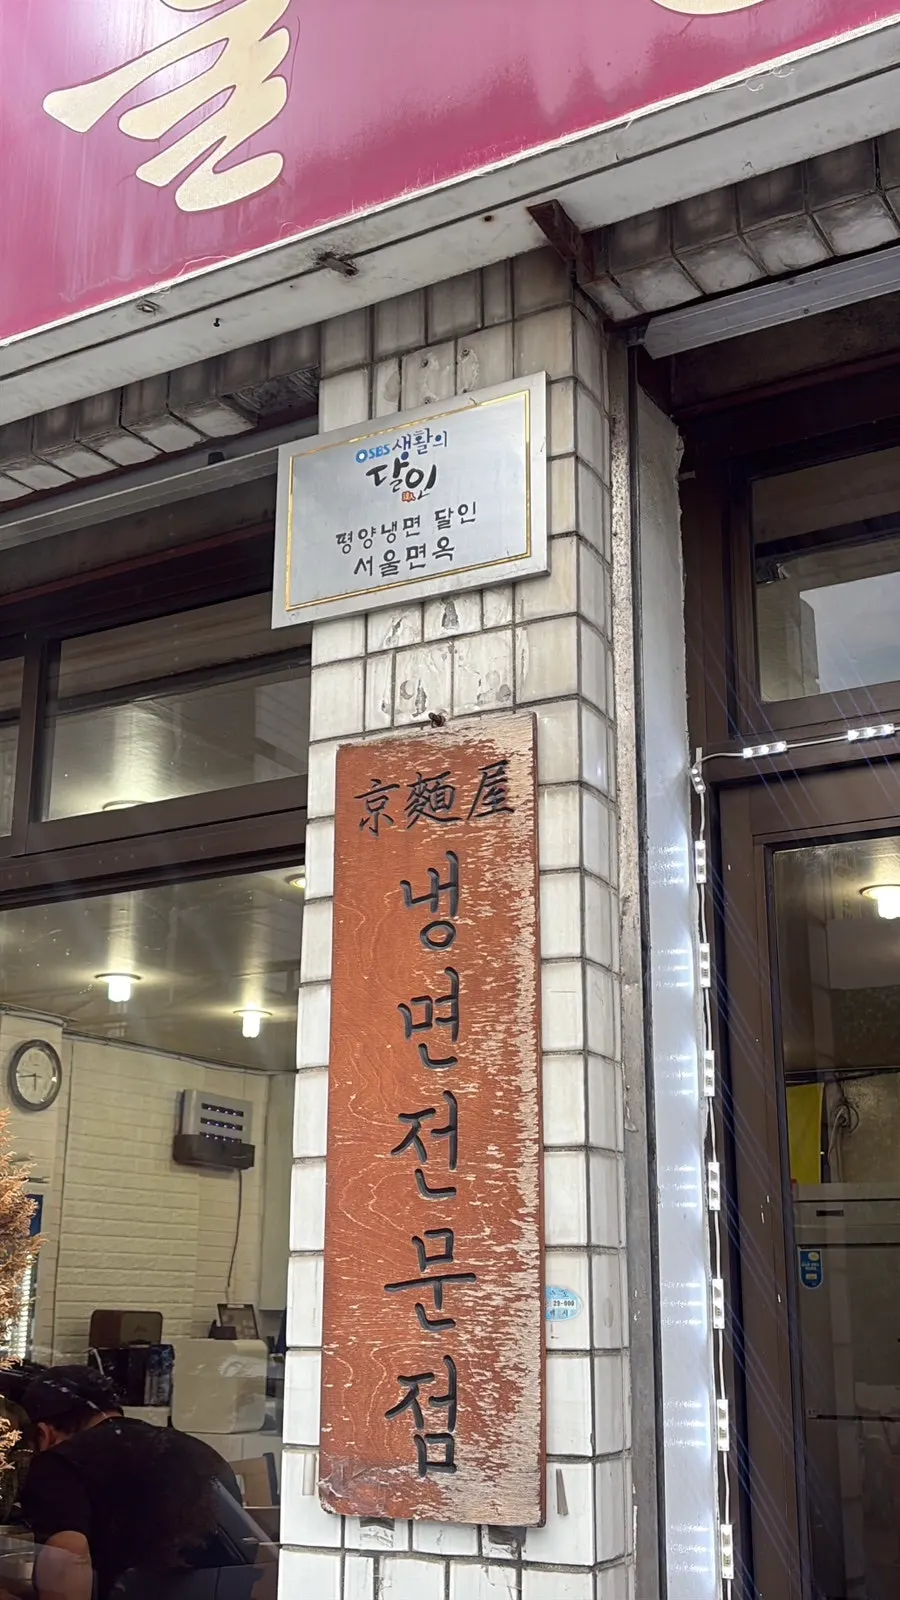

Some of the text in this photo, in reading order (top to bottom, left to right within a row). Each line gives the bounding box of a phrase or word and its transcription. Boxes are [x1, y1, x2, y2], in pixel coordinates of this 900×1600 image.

[391, 427, 448, 461] 생활의
[365, 457, 437, 500] 달인
[335, 501, 477, 555] 평양냉면 달인
[353, 536, 456, 578] 서울면옥
